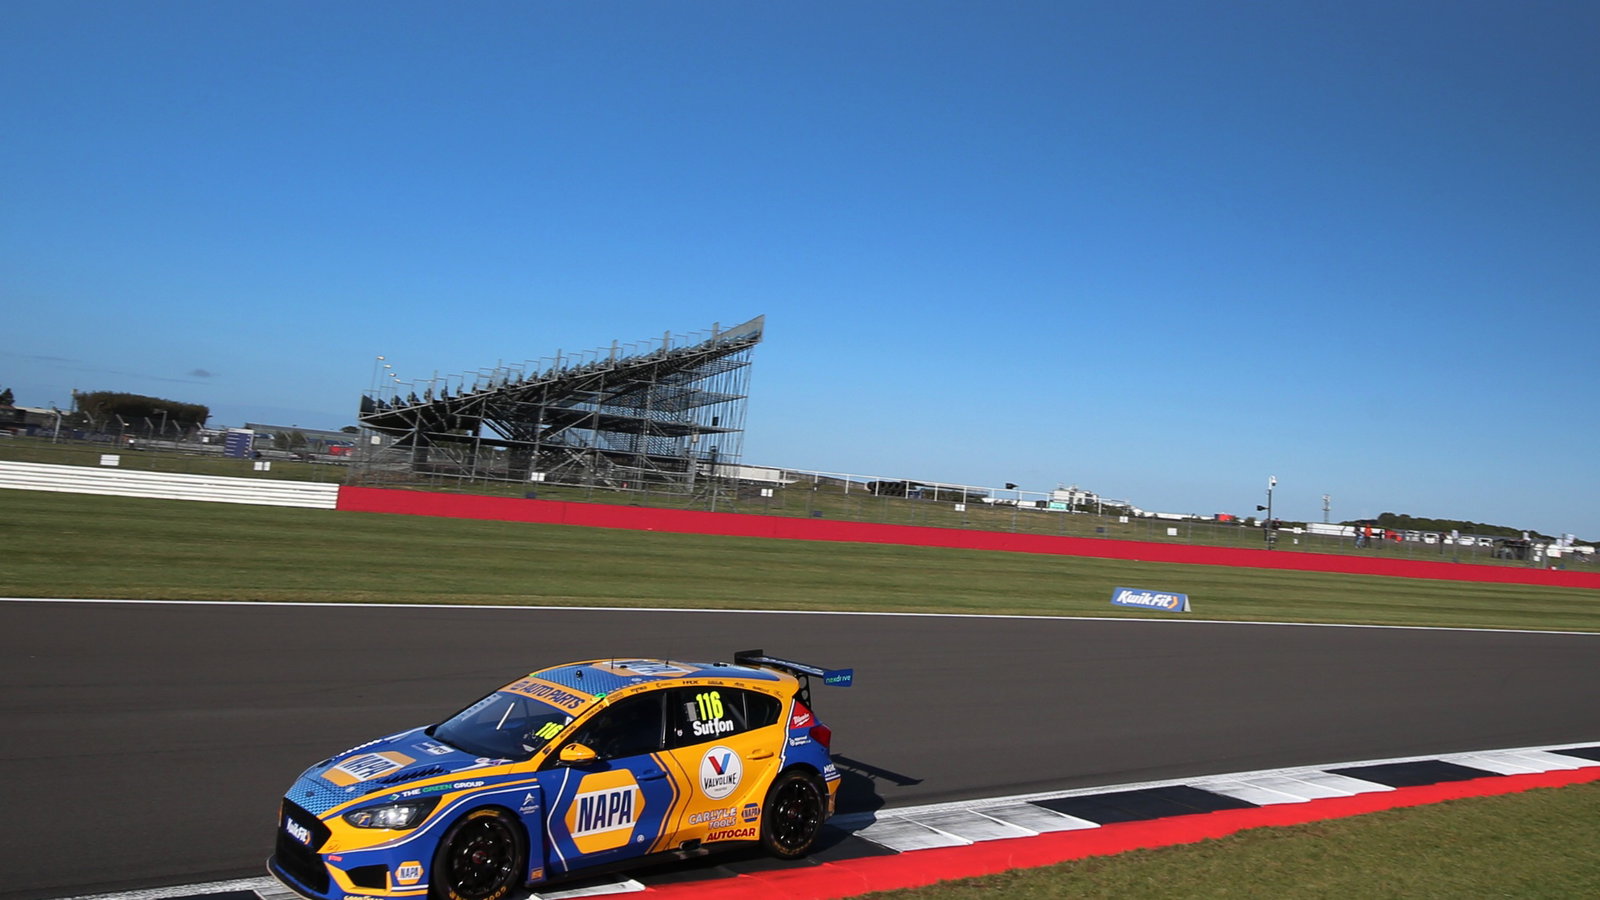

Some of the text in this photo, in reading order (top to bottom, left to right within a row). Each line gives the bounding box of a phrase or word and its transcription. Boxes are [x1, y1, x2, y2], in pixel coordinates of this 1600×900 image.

[825, 675, 851, 684] nexdrive
[522, 683, 554, 698] AUTO
[547, 689, 586, 709] PARTS
[696, 691, 724, 721] 116
[535, 722, 565, 740] 116
[692, 717, 735, 737] Sutton
[341, 754, 398, 779] NAPA
[402, 780, 485, 798] THE GREEN GROUP
[703, 772, 738, 790] VALVOLINE
[577, 789, 633, 833] NAPA
[688, 807, 737, 825] CARLYLE
[742, 807, 760, 818] NAPA
[707, 817, 737, 830] TOOLS
[706, 827, 756, 841] AUTOCAR
[400, 867, 419, 879] NAPA
